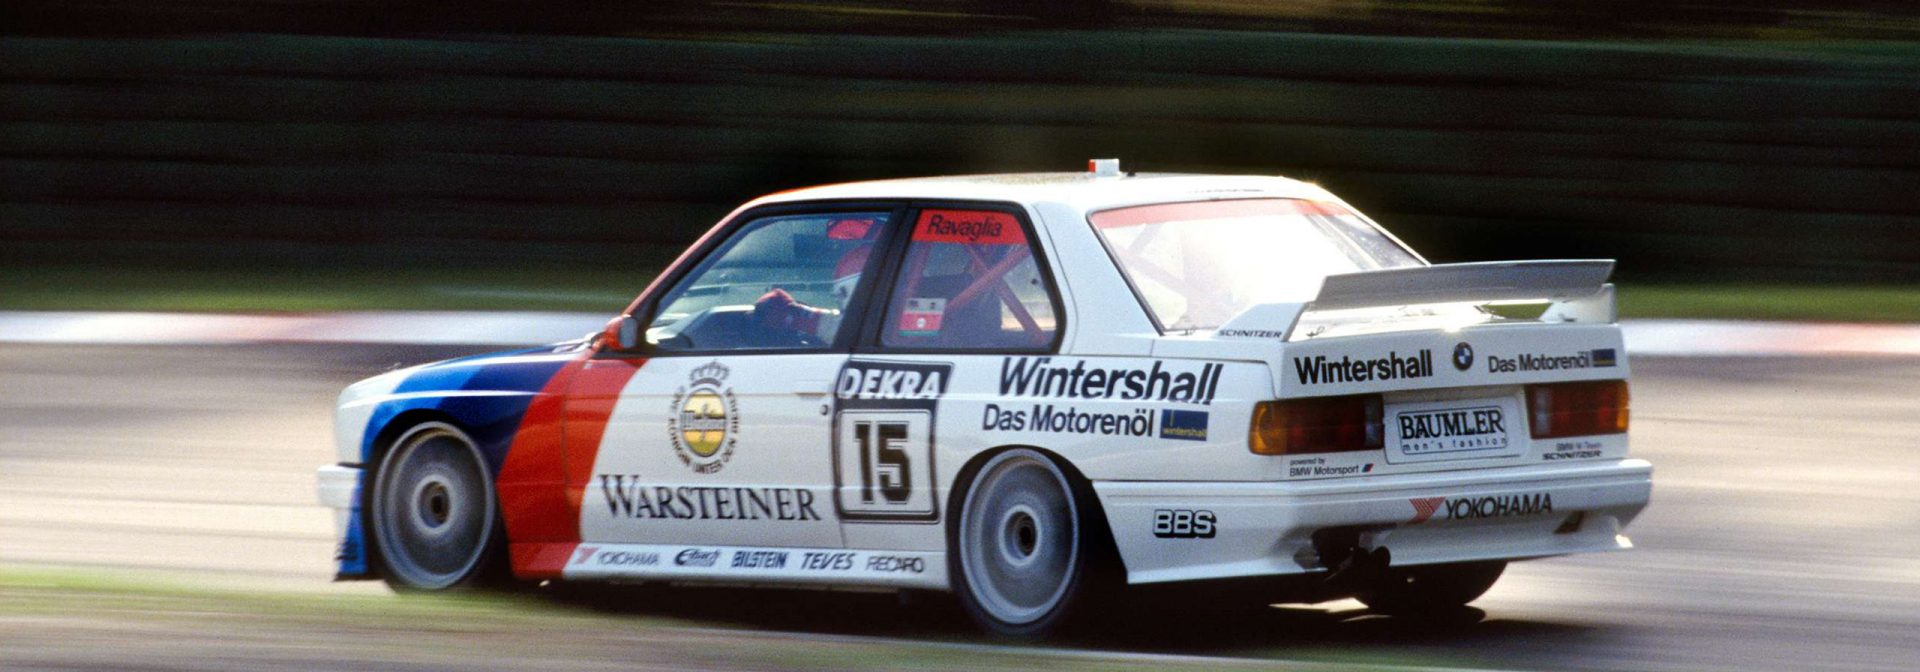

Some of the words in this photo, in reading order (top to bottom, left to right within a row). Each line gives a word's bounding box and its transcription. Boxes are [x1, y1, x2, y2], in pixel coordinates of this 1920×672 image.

[927, 214, 1003, 241] Ravaglia
[1218, 329, 1282, 338] SCHNITZER
[1294, 350, 1432, 385] Wintershall
[1488, 356, 1517, 373] Das
[1519, 351, 1589, 371] Motorenöl
[838, 368, 941, 399] DEKRA
[999, 357, 1224, 405] Wintershall
[982, 404, 1025, 431] Das
[1030, 404, 1155, 437] Motorenöl
[1452, 438, 1508, 448] fashion
[854, 421, 912, 504] 15
[1290, 466, 1312, 477] BMW
[1314, 465, 1359, 475] Motorsport
[599, 475, 821, 521] WARSTEINER
[1445, 494, 1553, 519] YOKOHAMA
[1154, 509, 1217, 538] BBS
[731, 551, 789, 568] BILSTEIN
[802, 552, 857, 570] TEVES
[865, 555, 925, 573] RECARO
